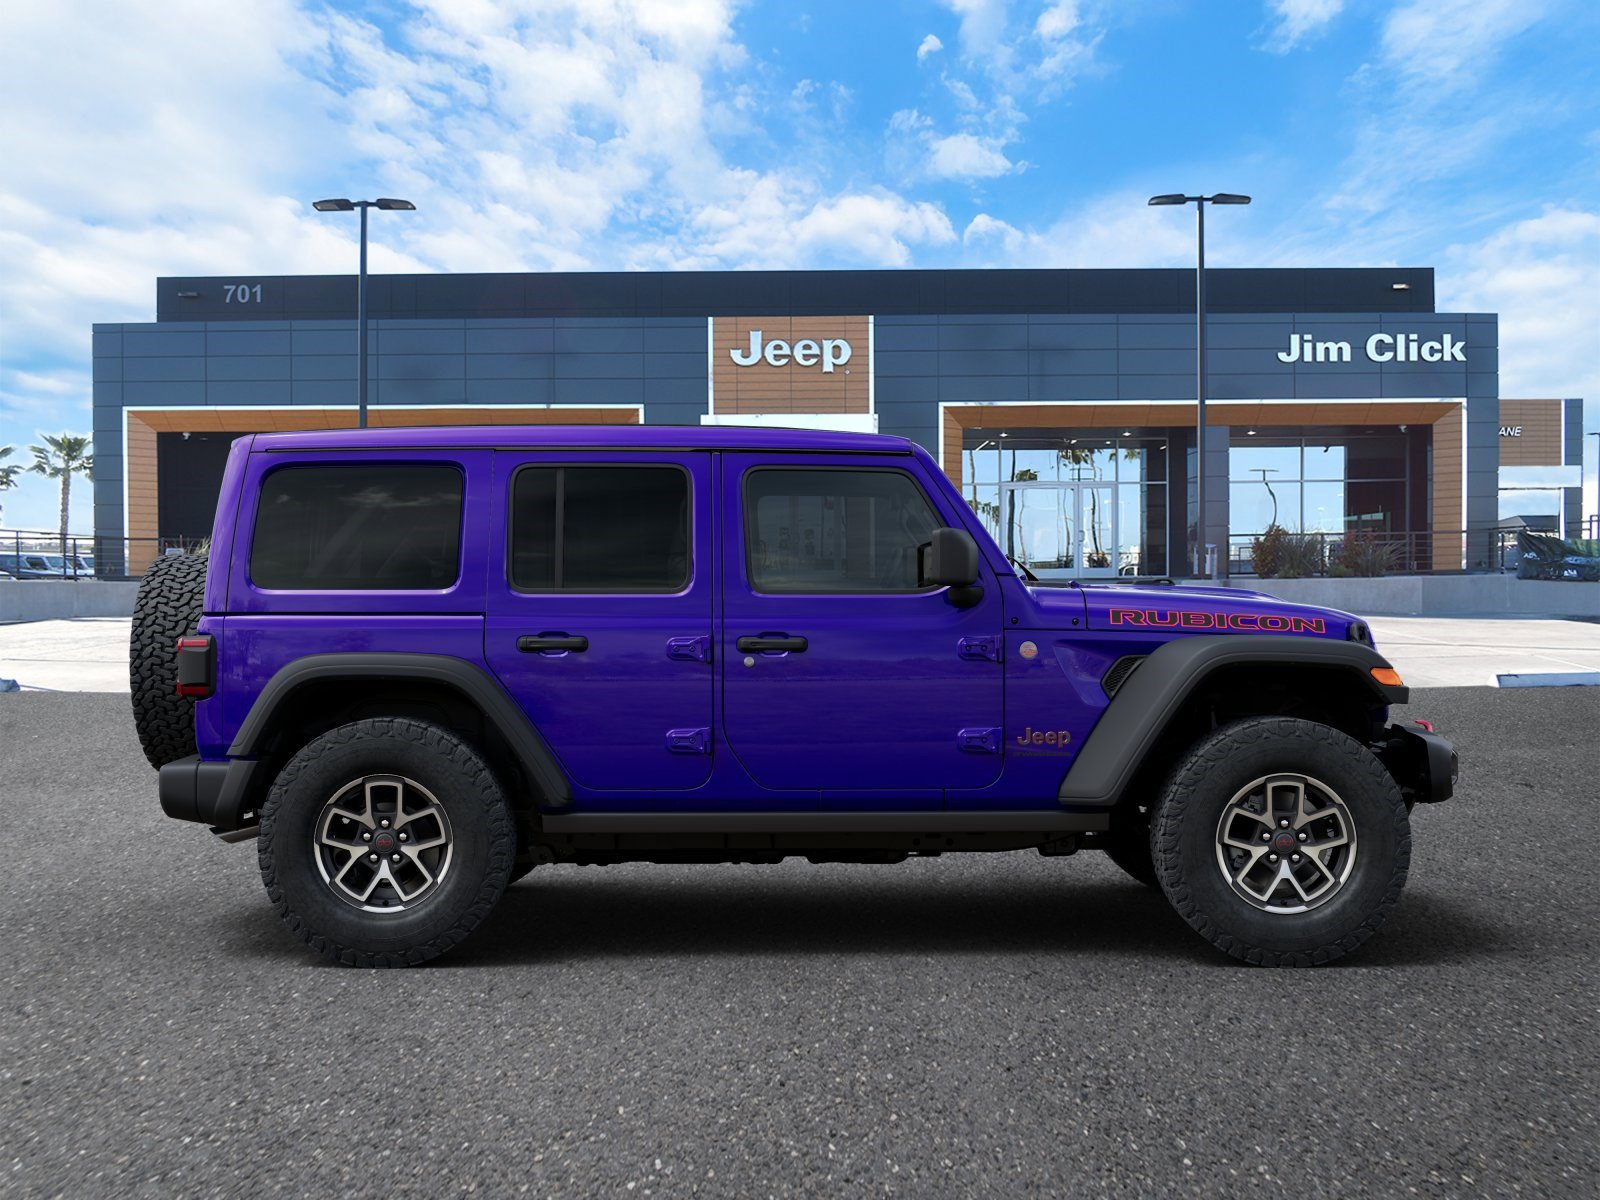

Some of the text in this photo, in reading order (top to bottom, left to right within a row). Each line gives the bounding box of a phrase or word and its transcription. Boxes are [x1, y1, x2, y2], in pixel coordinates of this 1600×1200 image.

[223, 284, 261, 303] 701
[730, 330, 852, 373] Jeep
[1277, 333, 1467, 362] Jim Click
[1109, 608, 1326, 634] RUBICON
[1017, 727, 1071, 748] Jeep
